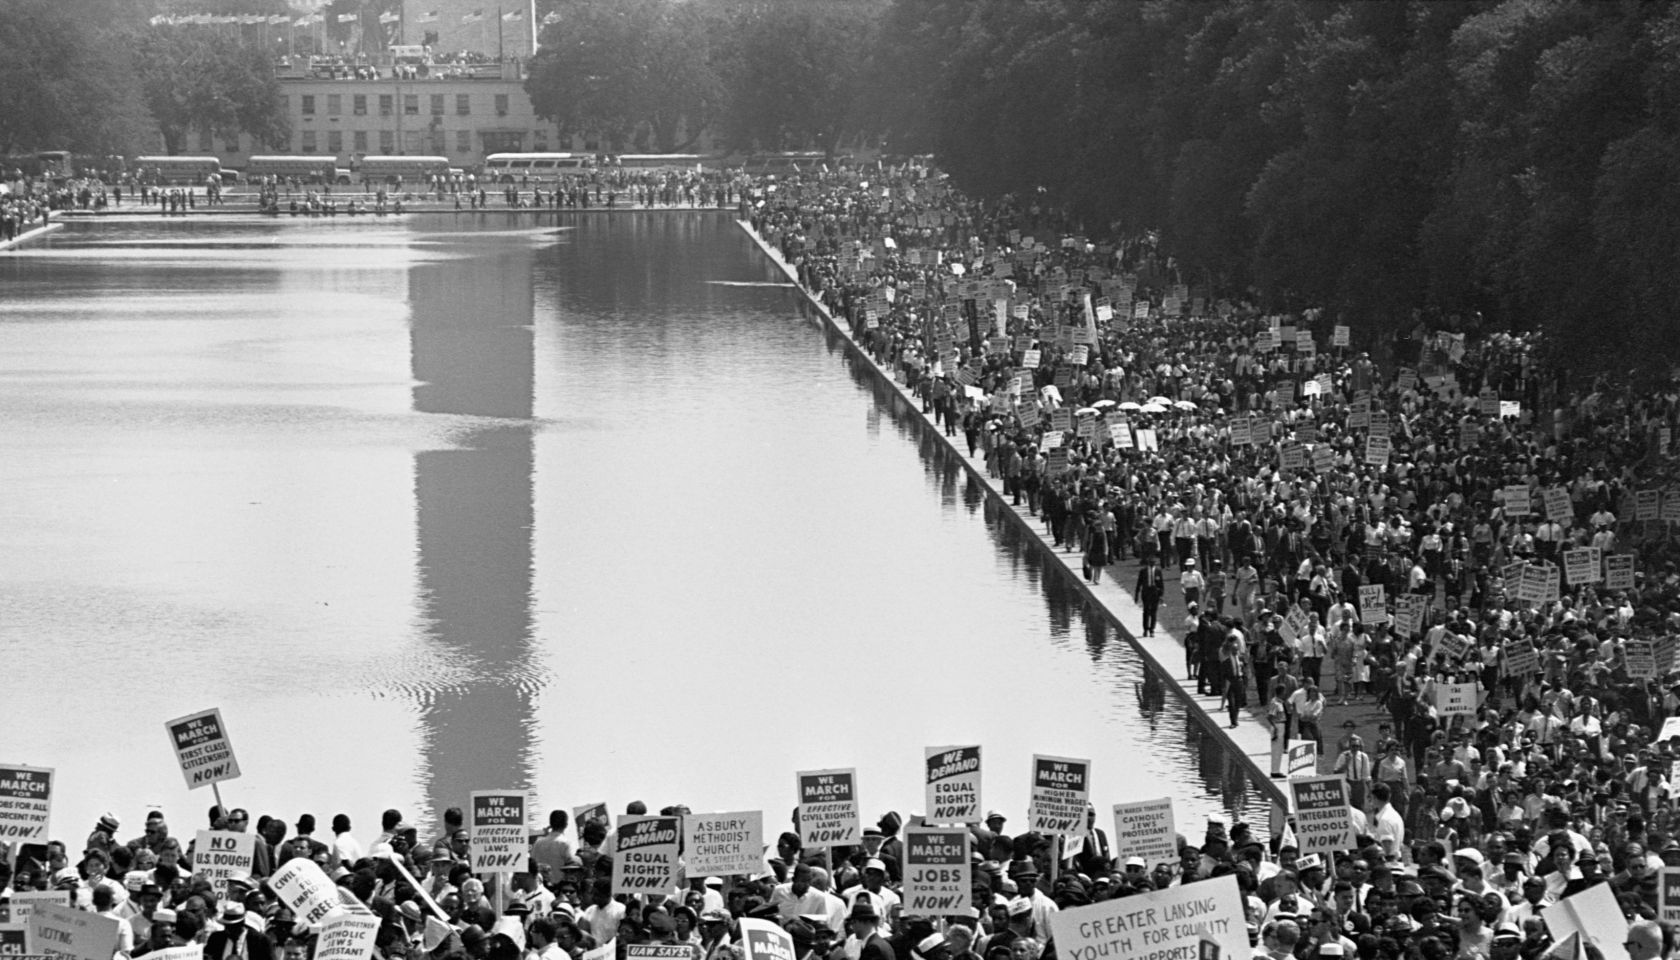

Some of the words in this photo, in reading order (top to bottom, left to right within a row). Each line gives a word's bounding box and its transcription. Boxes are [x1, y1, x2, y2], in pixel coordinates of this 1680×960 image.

[187, 719, 203, 729] WE
[178, 723, 218, 743] MARCH
[192, 736, 209, 744] FOR
[180, 747, 203, 761] FIRST
[204, 742, 227, 754] CLASS
[942, 750, 964, 764] WE
[182, 750, 230, 770] CITIZENSHIP
[193, 762, 231, 783] NOW!
[930, 758, 978, 780] DEMAND
[1053, 763, 1069, 772] WE
[15, 772, 33, 781] WE
[817, 776, 834, 784] WE
[1038, 770, 1082, 783] MARCH
[0, 779, 46, 792] MARCH
[805, 784, 849, 796] MARCH
[936, 782, 975, 793] EQUAL
[1310, 783, 1326, 791] WE
[935, 793, 976, 805] RIGHTS
[1033, 794, 1063, 804] MINIMUM
[1064, 798, 1087, 806] WAGES
[1044, 790, 1076, 798] HIGHER
[1299, 790, 1341, 803] MARCH
[0, 801, 14, 809] OBS
[15, 802, 31, 810] FOR
[33, 803, 48, 811] ALL
[488, 797, 505, 806] WE
[1035, 802, 1069, 811] COVERAGE
[477, 806, 520, 818] MARCH
[806, 804, 852, 813] EFFECTIVE
[934, 804, 977, 819] NOW!
[1298, 808, 1348, 821] INTEGRATED
[0, 812, 28, 821] DECENT
[30, 814, 47, 822] PAY
[801, 813, 824, 822] CIVIL
[824, 811, 856, 820] RIGHTS
[1049, 811, 1081, 819] WORKERS
[1122, 812, 1165, 824] CATHOLIC
[635, 820, 659, 834] WE
[697, 819, 747, 832] ASBURY
[816, 821, 842, 829] LAWS
[1035, 816, 1080, 831] NOW!
[1131, 821, 1157, 830] JEWS
[1300, 821, 1349, 833] SCHOOLS
[0, 824, 43, 838] NOW!
[477, 827, 522, 835] EFFECTIVE
[808, 827, 854, 843] NOW!
[1121, 826, 1168, 838] PROTESTANT
[211, 837, 237, 850] NO
[472, 836, 491, 844] CIVIL
[491, 836, 525, 844] RIGHTS
[620, 829, 675, 849] DEMAND
[693, 831, 751, 844] METHODIST
[927, 835, 945, 844] WE
[1307, 831, 1349, 847] NOW!
[484, 844, 509, 852] LAWS
[696, 843, 740, 855] CHURCH
[912, 844, 961, 856] MARCH
[214, 853, 251, 867] DOUGH
[477, 852, 522, 868] NOW!
[625, 853, 669, 864] EQUAL
[215, 869, 230, 878] HE
[623, 864, 670, 876] RIGHTS
[912, 869, 961, 883] JOBS
[274, 870, 297, 890] CIVIL
[621, 876, 671, 889] NOW!
[292, 886, 319, 908] EMPLO
[912, 894, 964, 909] NOW!
[306, 898, 335, 924] FREE
[1079, 907, 1157, 939] GREATER
[1163, 897, 1217, 922] LANSING
[38, 926, 73, 945] VOTING
[323, 930, 366, 942] CATHOLIC
[326, 938, 353, 948] JEWS
[1069, 938, 1133, 960] YOUTH
[1142, 927, 1170, 946] FOR
[318, 947, 365, 959] PROTESTANT
[630, 947, 658, 956] UAW
[658, 947, 690, 957] SAYS:
[754, 942, 792, 958] MARCH
